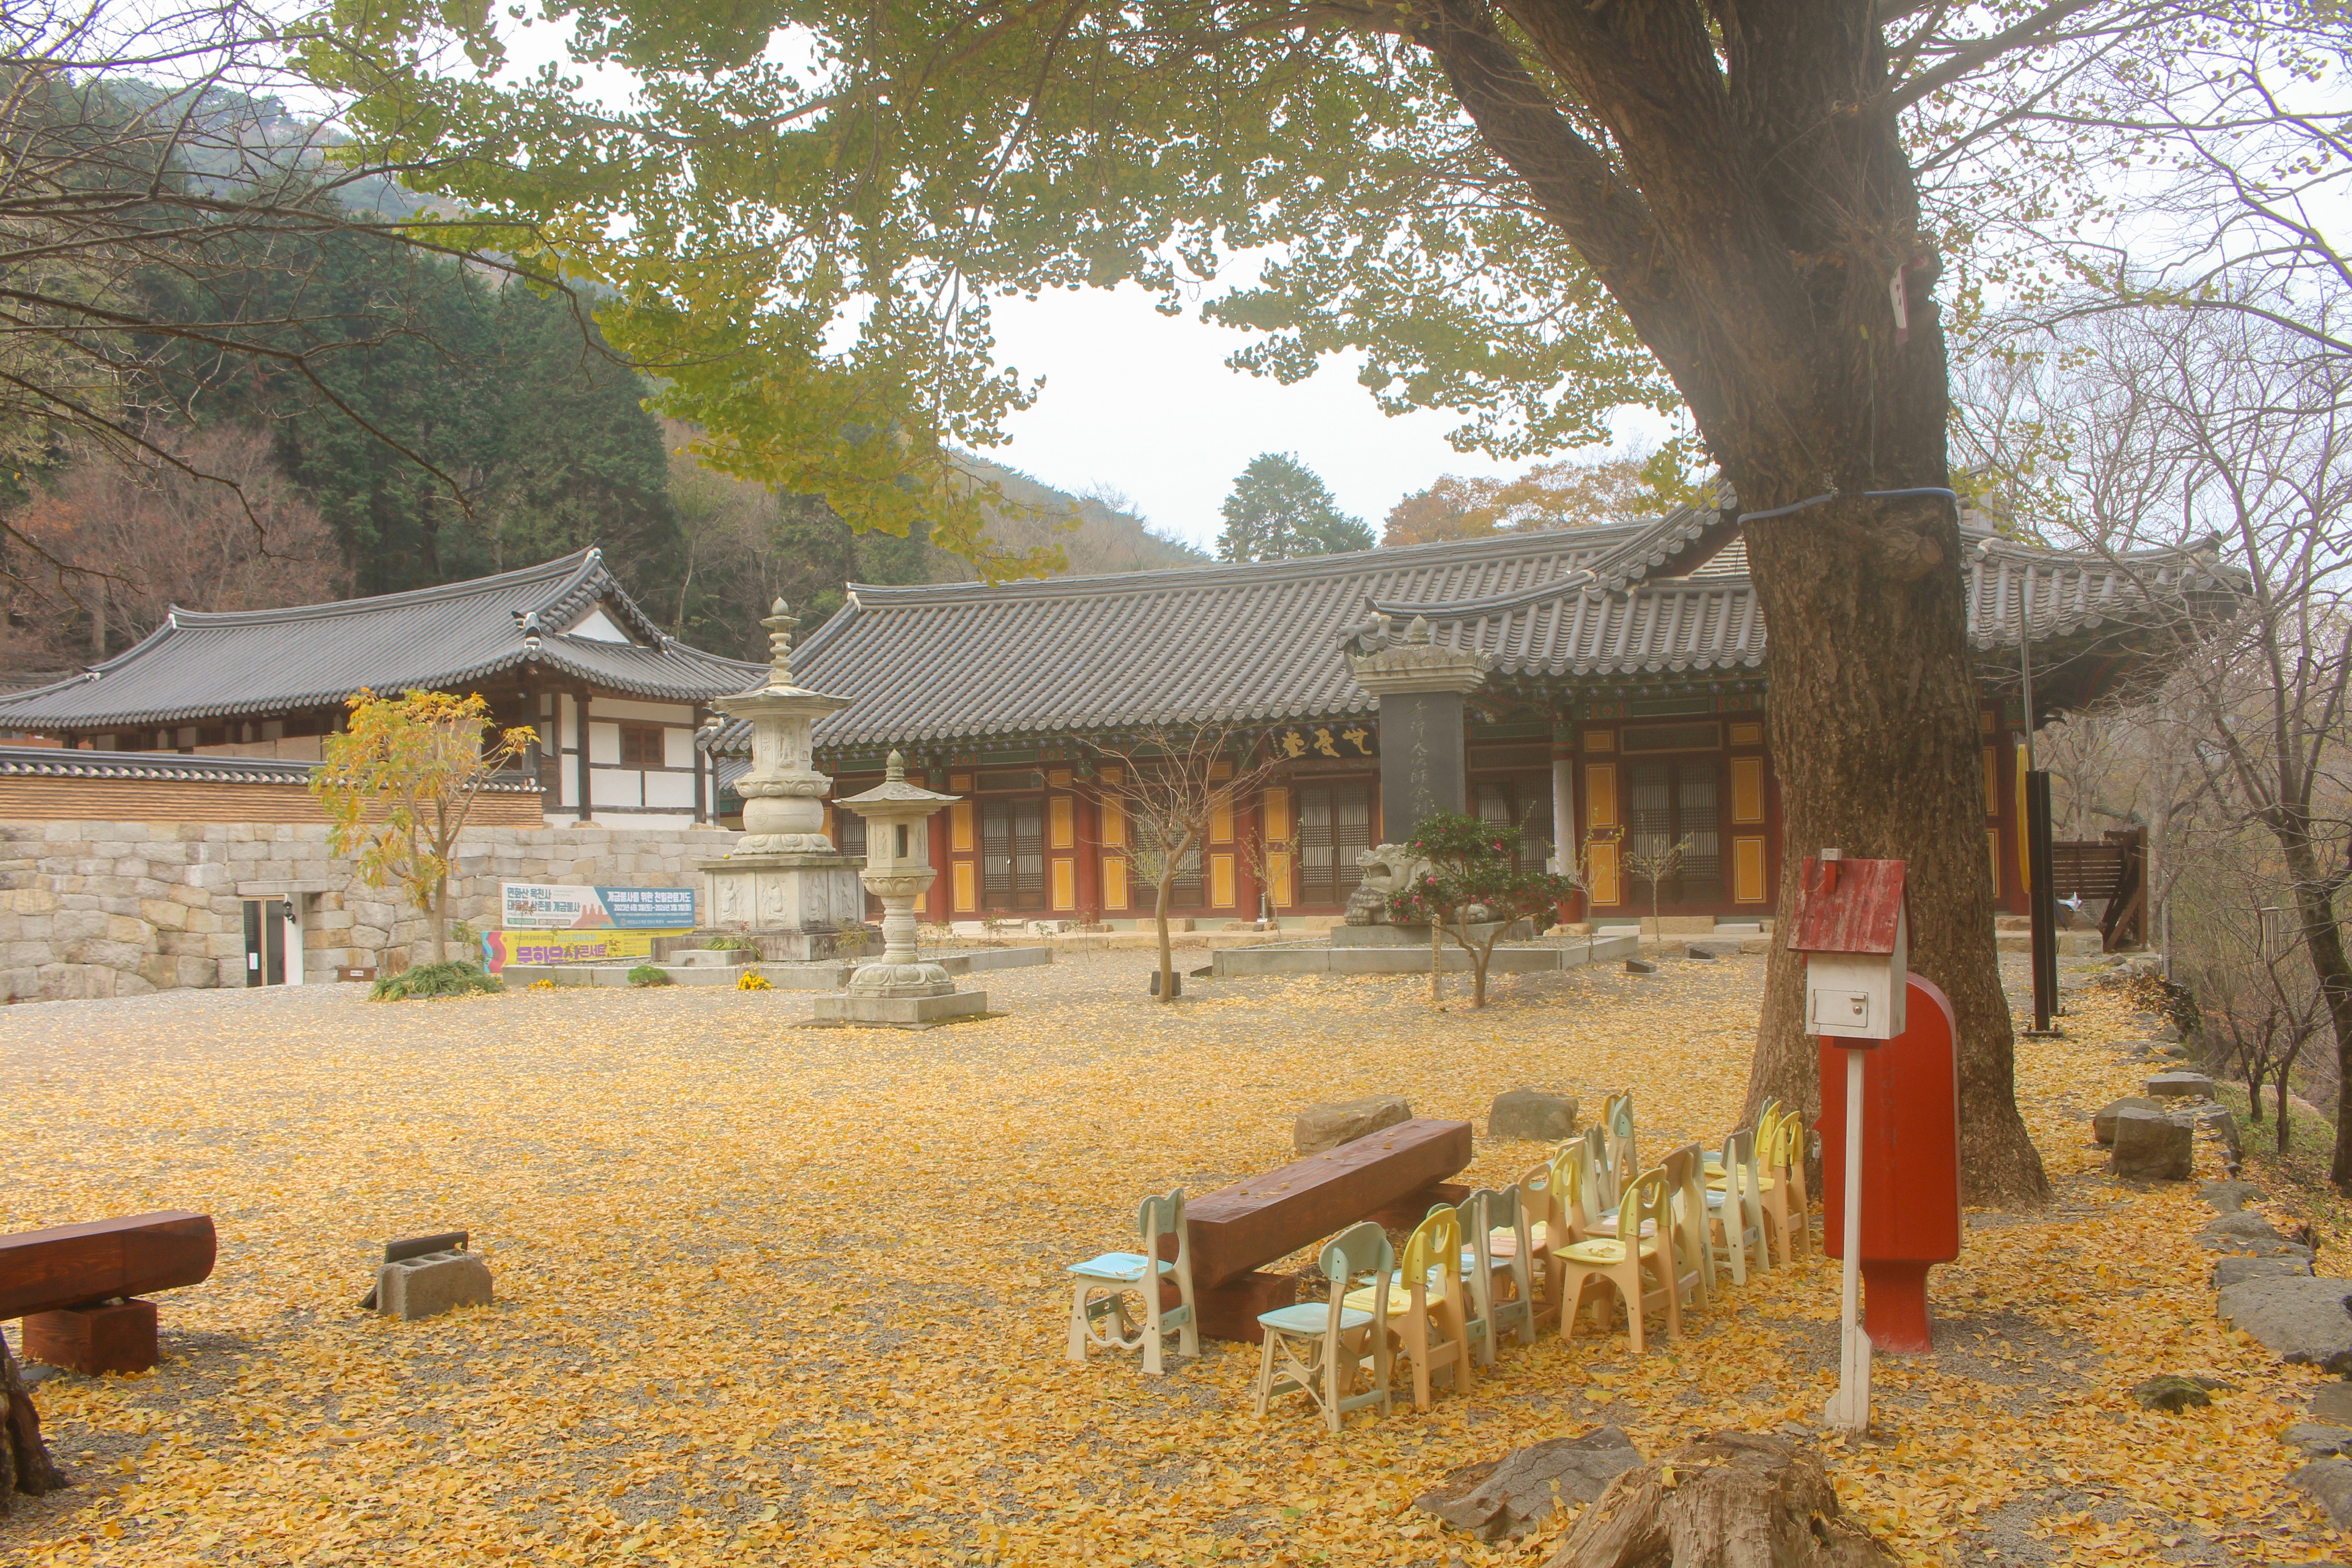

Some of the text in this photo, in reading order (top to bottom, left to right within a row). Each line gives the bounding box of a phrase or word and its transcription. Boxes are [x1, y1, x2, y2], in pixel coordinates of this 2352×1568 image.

[507, 887, 529, 899] 연화산
[530, 888, 551, 899] 옥천사
[607, 891, 691, 903] 개금불사를 위한 천일관음기도
[531, 900, 551, 912] 삼존불
[553, 901, 580, 912] 개금불사
[557, 934, 571, 942] 2023
